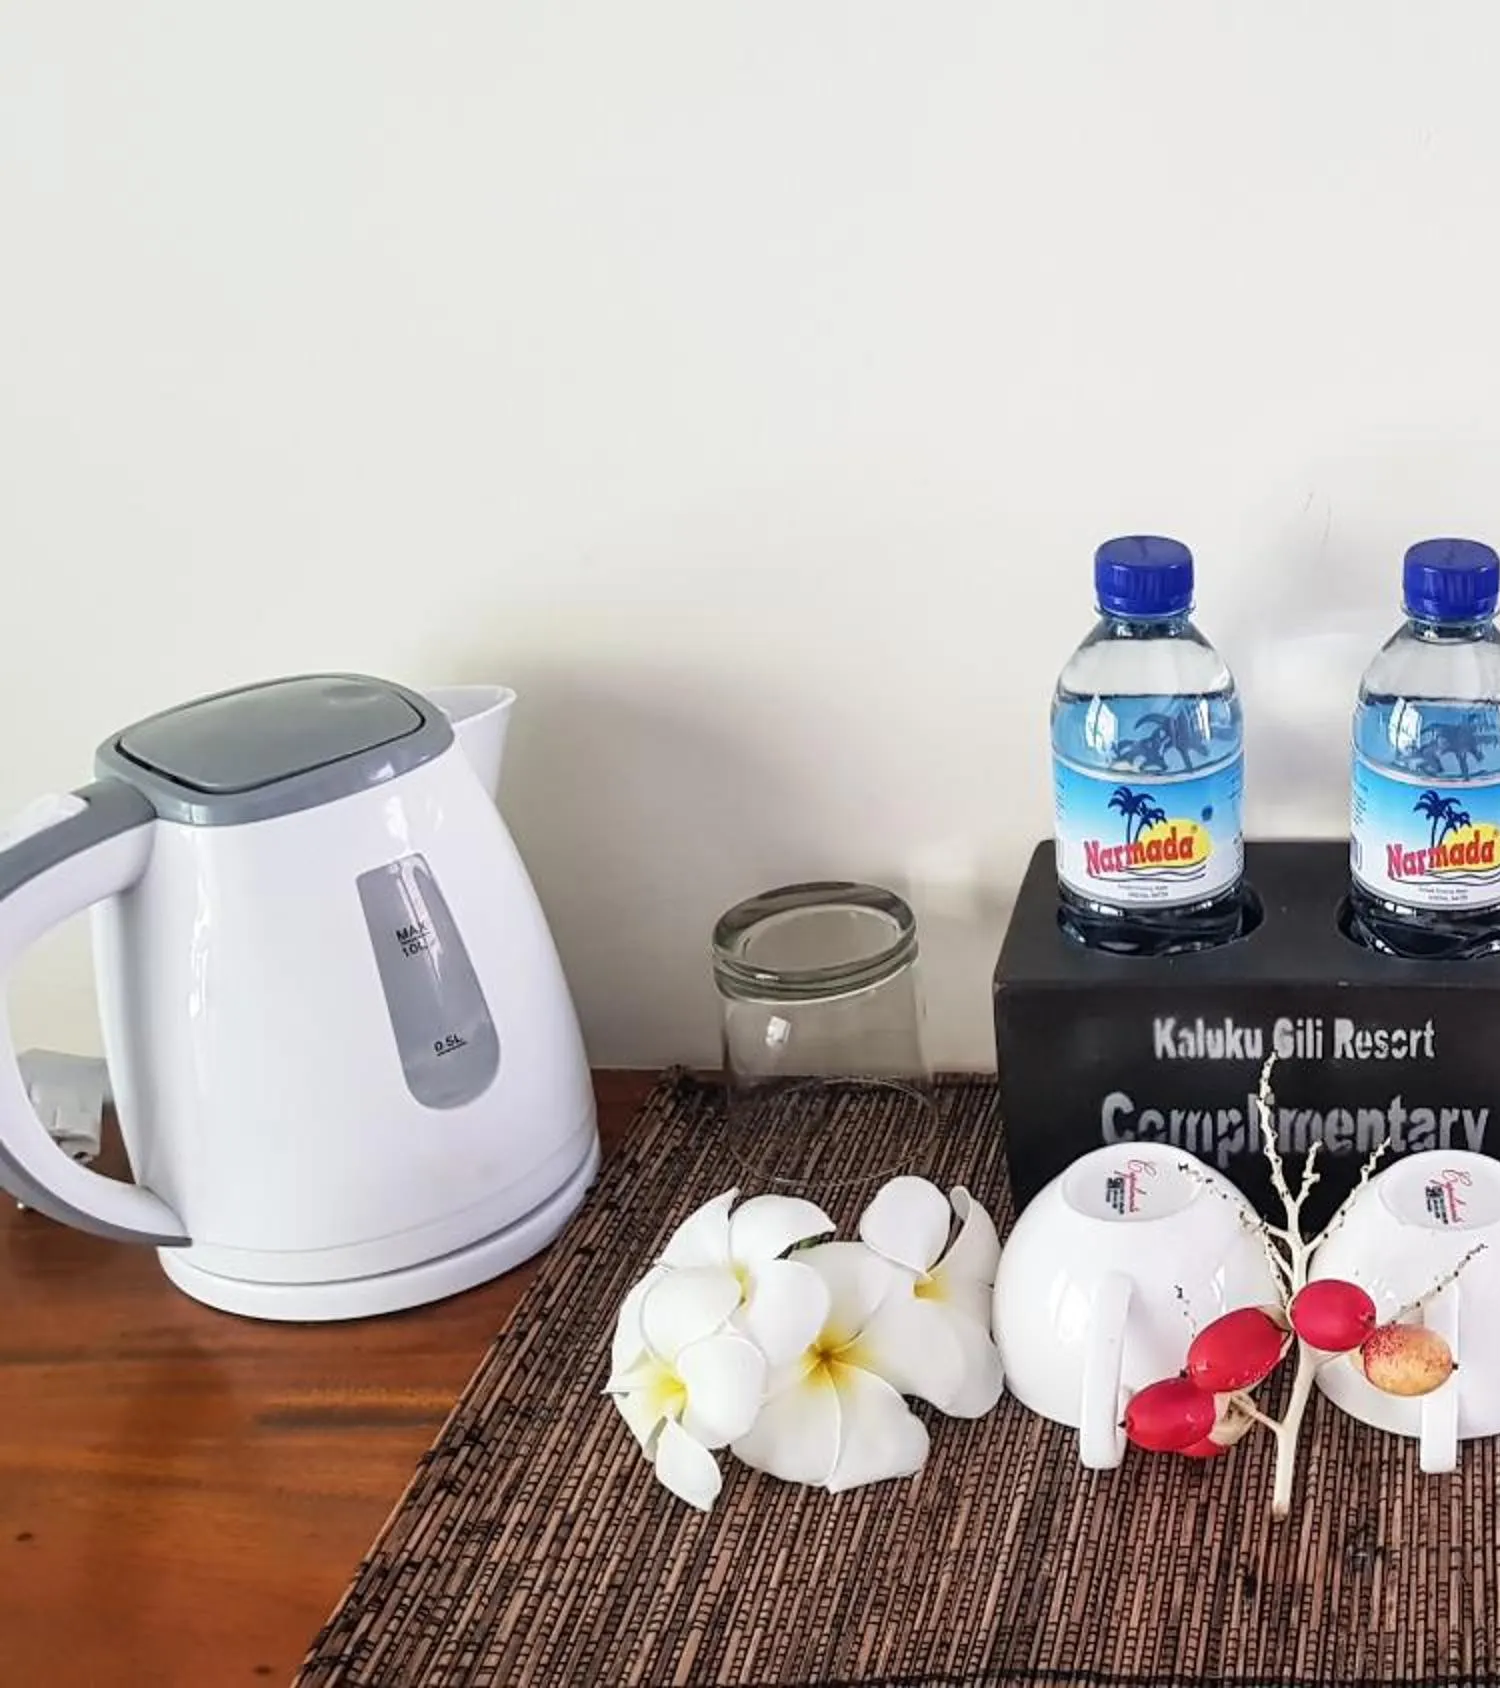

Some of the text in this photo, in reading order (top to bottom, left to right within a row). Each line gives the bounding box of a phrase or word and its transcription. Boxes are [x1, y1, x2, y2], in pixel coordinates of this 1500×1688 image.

[1083, 826, 1193, 874] Narmada
[1386, 829, 1495, 878] Narmada
[396, 921, 428, 941] MAX
[1153, 1017, 1435, 1059] Kaluku Gili Resort
